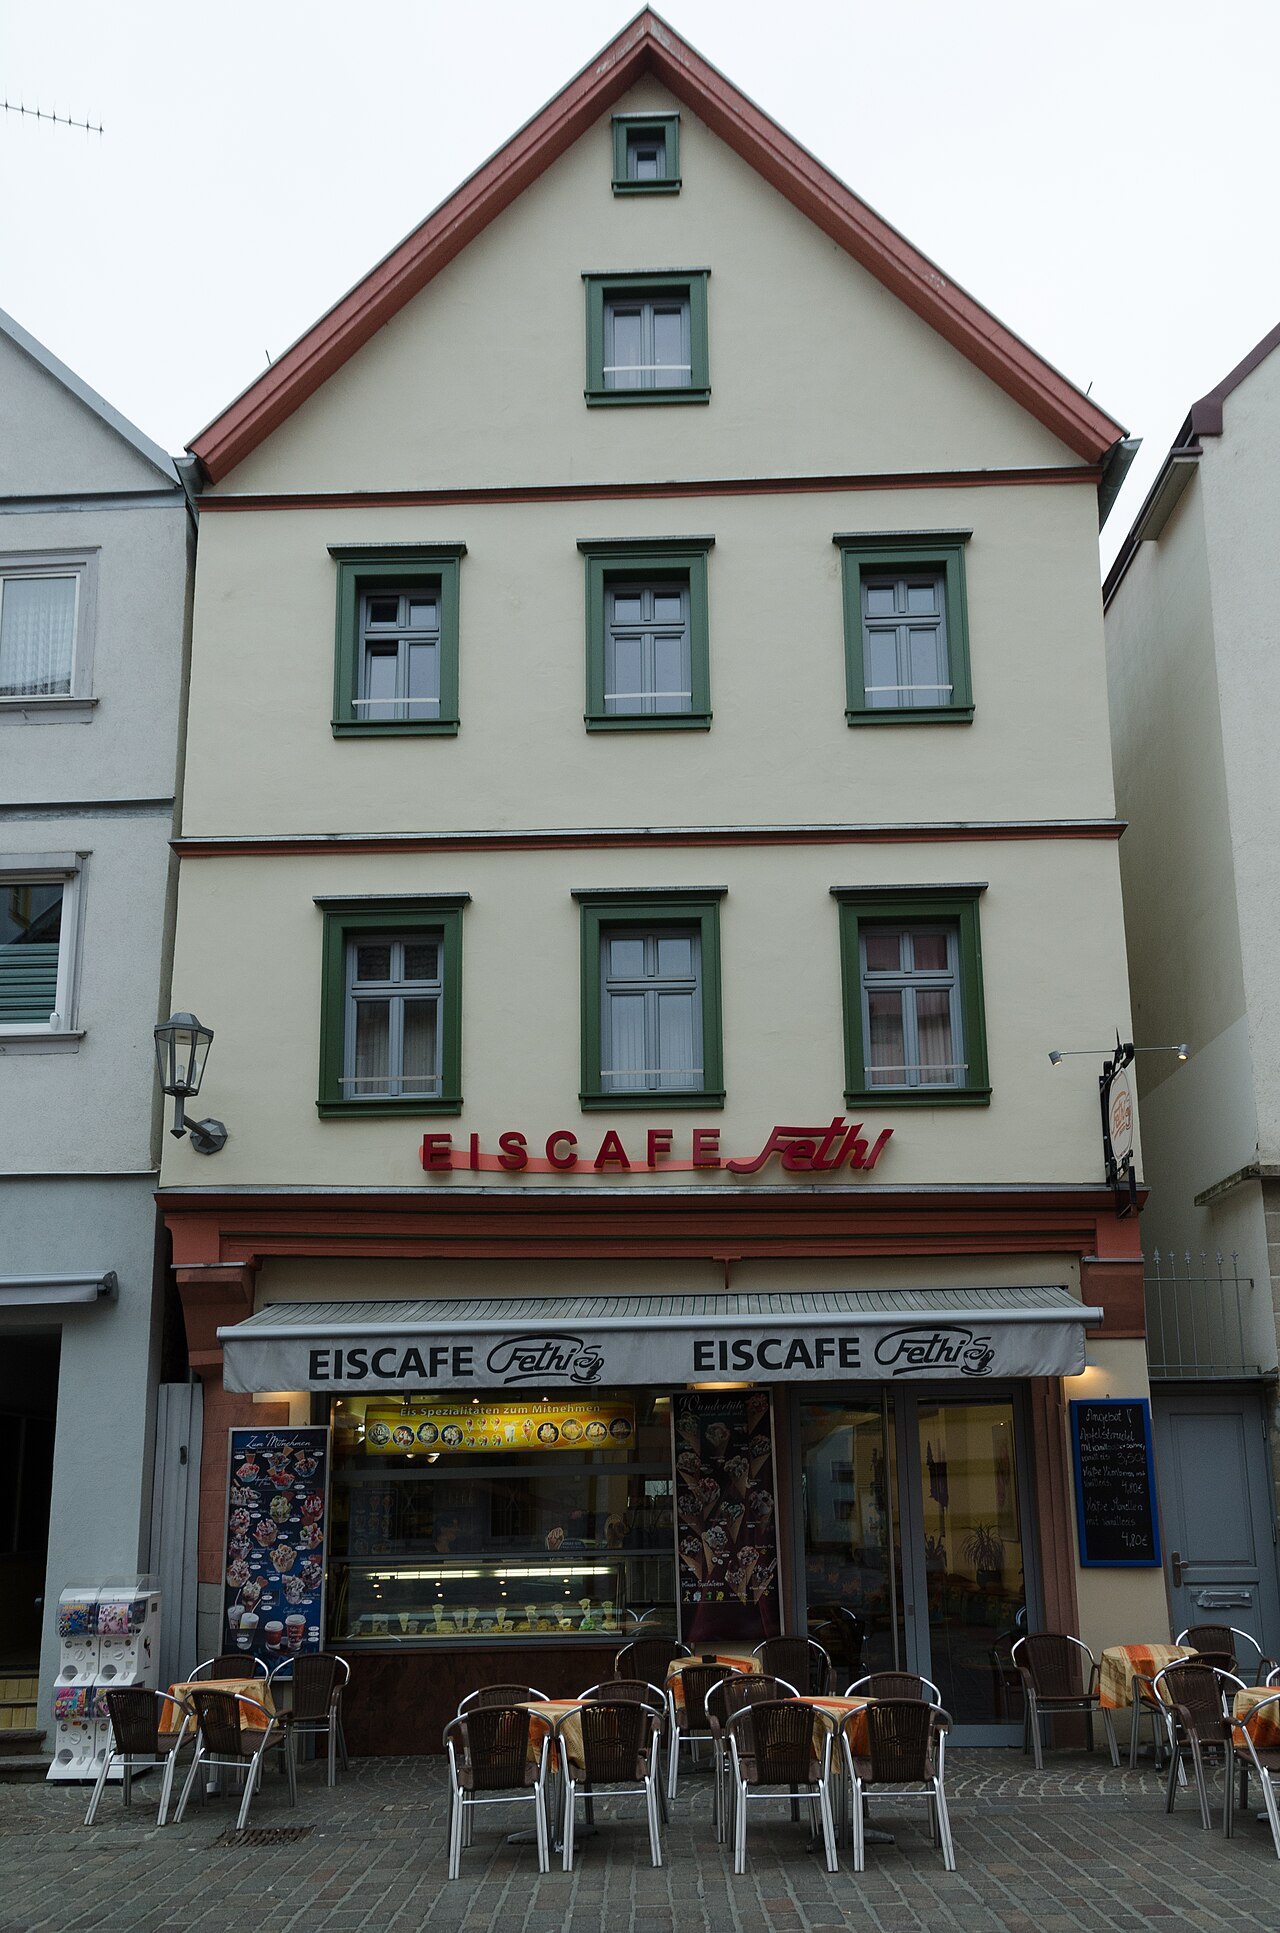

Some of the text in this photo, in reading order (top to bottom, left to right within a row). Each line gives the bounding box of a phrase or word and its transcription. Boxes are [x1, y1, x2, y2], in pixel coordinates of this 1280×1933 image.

[423, 1117, 895, 1175] EISCAFE Fethi
[309, 1346, 474, 1380] EISCAFE
[693, 1337, 861, 1371] EISCAFE
[400, 1403, 601, 1418] Eis Spezialitäten zum Mitnehmen
[1086, 1408, 1122, 1429] Angebot
[246, 1432, 312, 1449] Zum Mitnehmen
[1121, 1531, 1149, 1547] 4,80€
